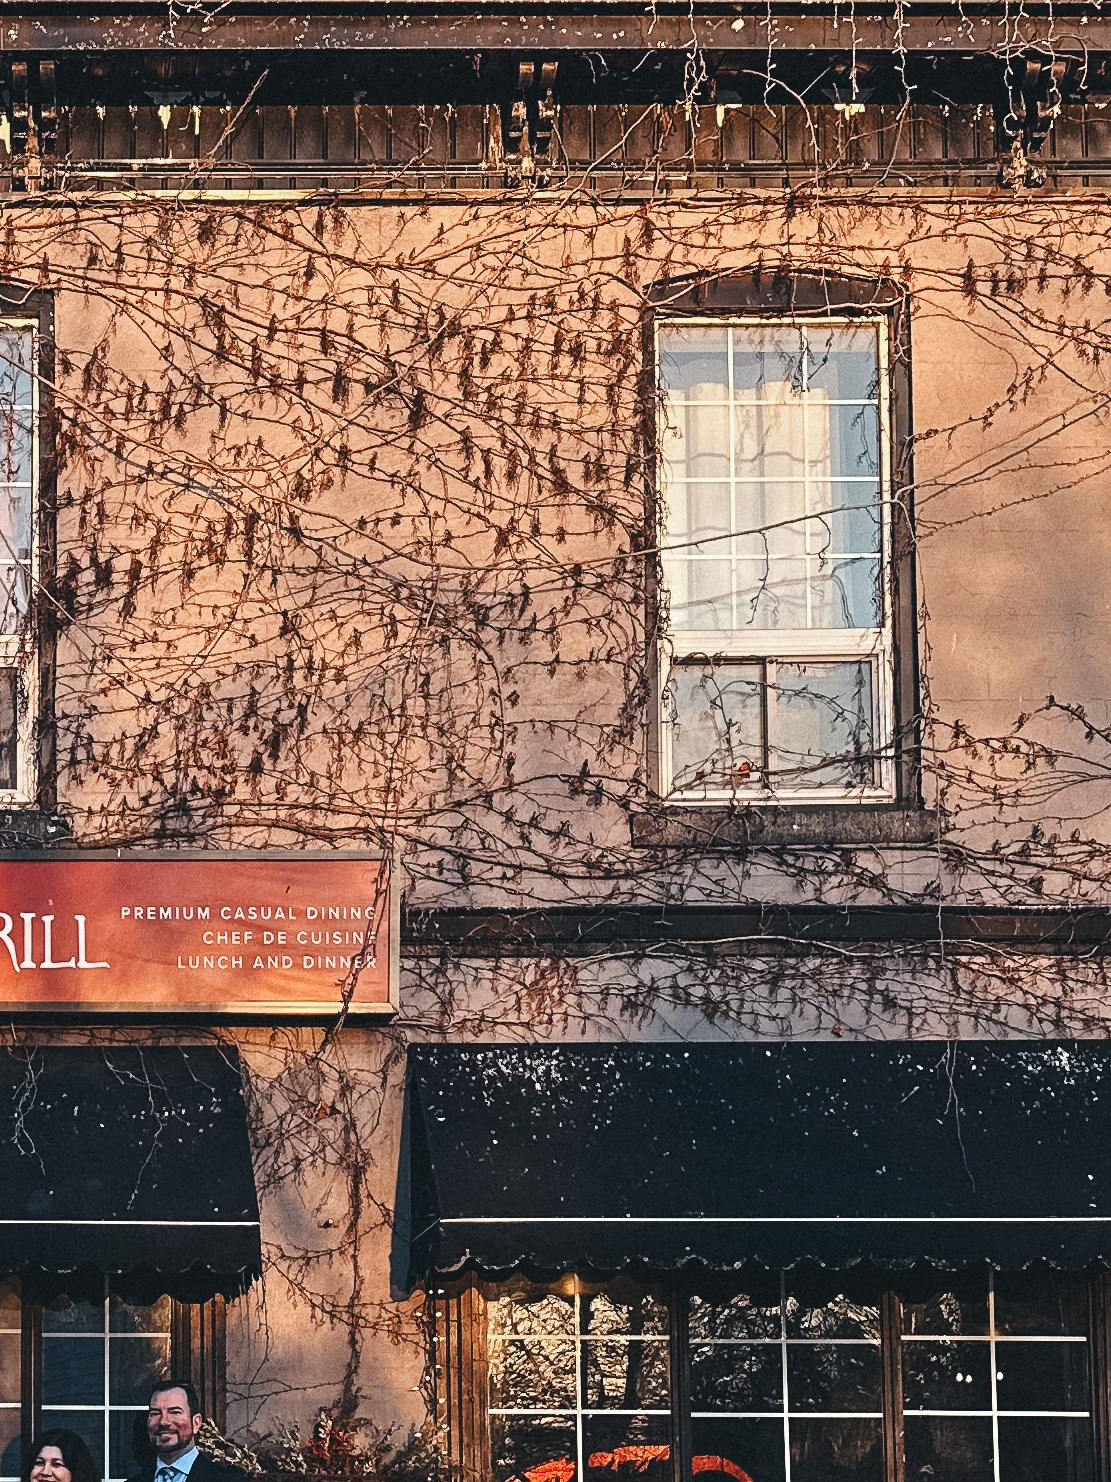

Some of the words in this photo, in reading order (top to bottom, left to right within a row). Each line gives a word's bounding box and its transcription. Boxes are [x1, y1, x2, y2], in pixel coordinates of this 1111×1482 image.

[121, 906, 210, 920] PREMIUM
[221, 906, 297, 920] CASUAL
[306, 906, 376, 920] DINING
[202, 931, 253, 945] CHEF
[263, 931, 287, 945] DE
[177, 955, 243, 969] LUNCH
[252, 955, 293, 969] AND
[303, 955, 376, 969] DINNER
